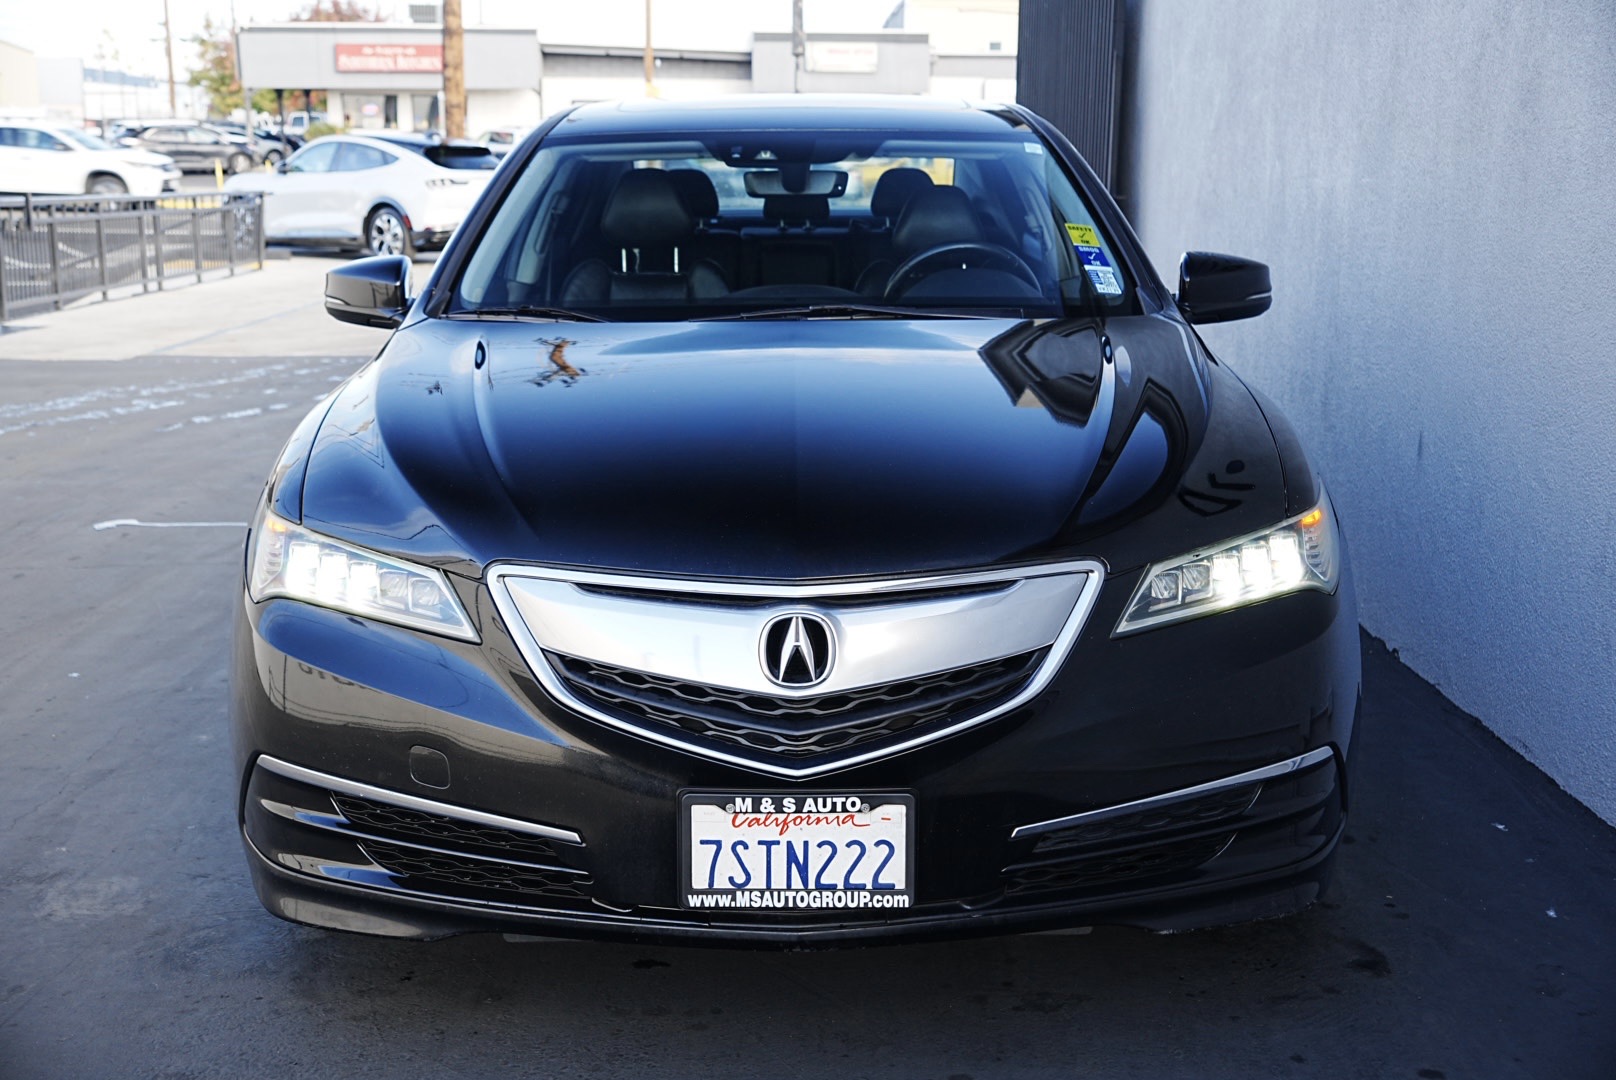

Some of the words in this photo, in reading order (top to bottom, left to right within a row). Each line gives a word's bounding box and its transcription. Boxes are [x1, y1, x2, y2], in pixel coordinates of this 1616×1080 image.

[734, 797, 752, 812] M
[759, 797, 776, 812] &
[783, 797, 796, 813] S
[803, 796, 861, 812] AUTO
[731, 812, 871, 836] California
[699, 839, 896, 889] 7STN222
[687, 891, 909, 908] www.MSAUTOGROUP.com
